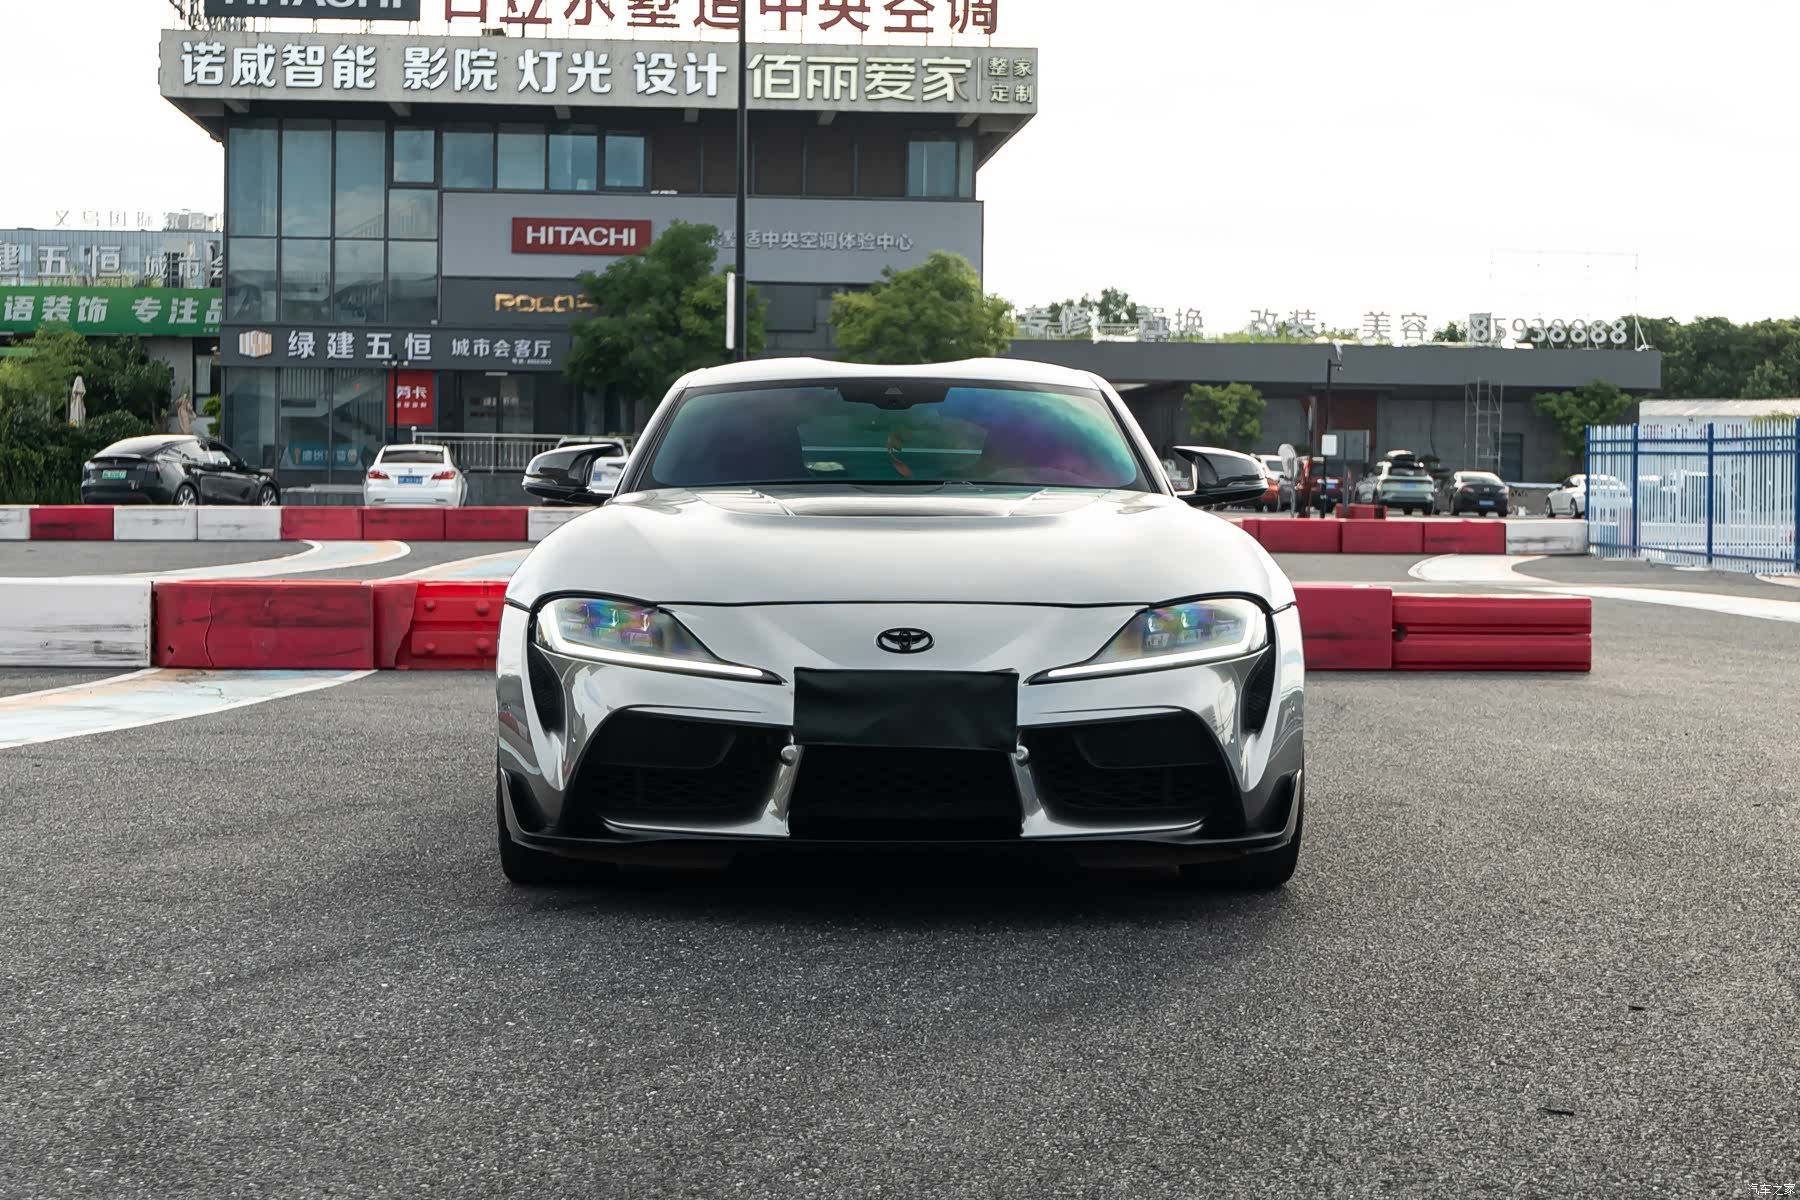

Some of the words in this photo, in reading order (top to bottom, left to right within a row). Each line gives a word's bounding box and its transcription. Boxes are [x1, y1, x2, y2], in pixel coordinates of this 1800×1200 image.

[181, 42, 377, 89] 诺威智能
[403, 47, 499, 92] 影院
[517, 49, 612, 94] 灯光
[633, 51, 728, 96] 设计
[747, 54, 972, 102] 佰丽爱家
[988, 57, 1033, 77] 整家
[990, 84, 1034, 104] 定制
[526, 225, 636, 247] HITACHI
[4, 295, 109, 323] 语装饰
[1250, 309, 1317, 338] 改装
[1363, 312, 1428, 341] 美容
[288, 330, 432, 360] 绿建五恒
[451, 338, 552, 358] 城市会客厅
